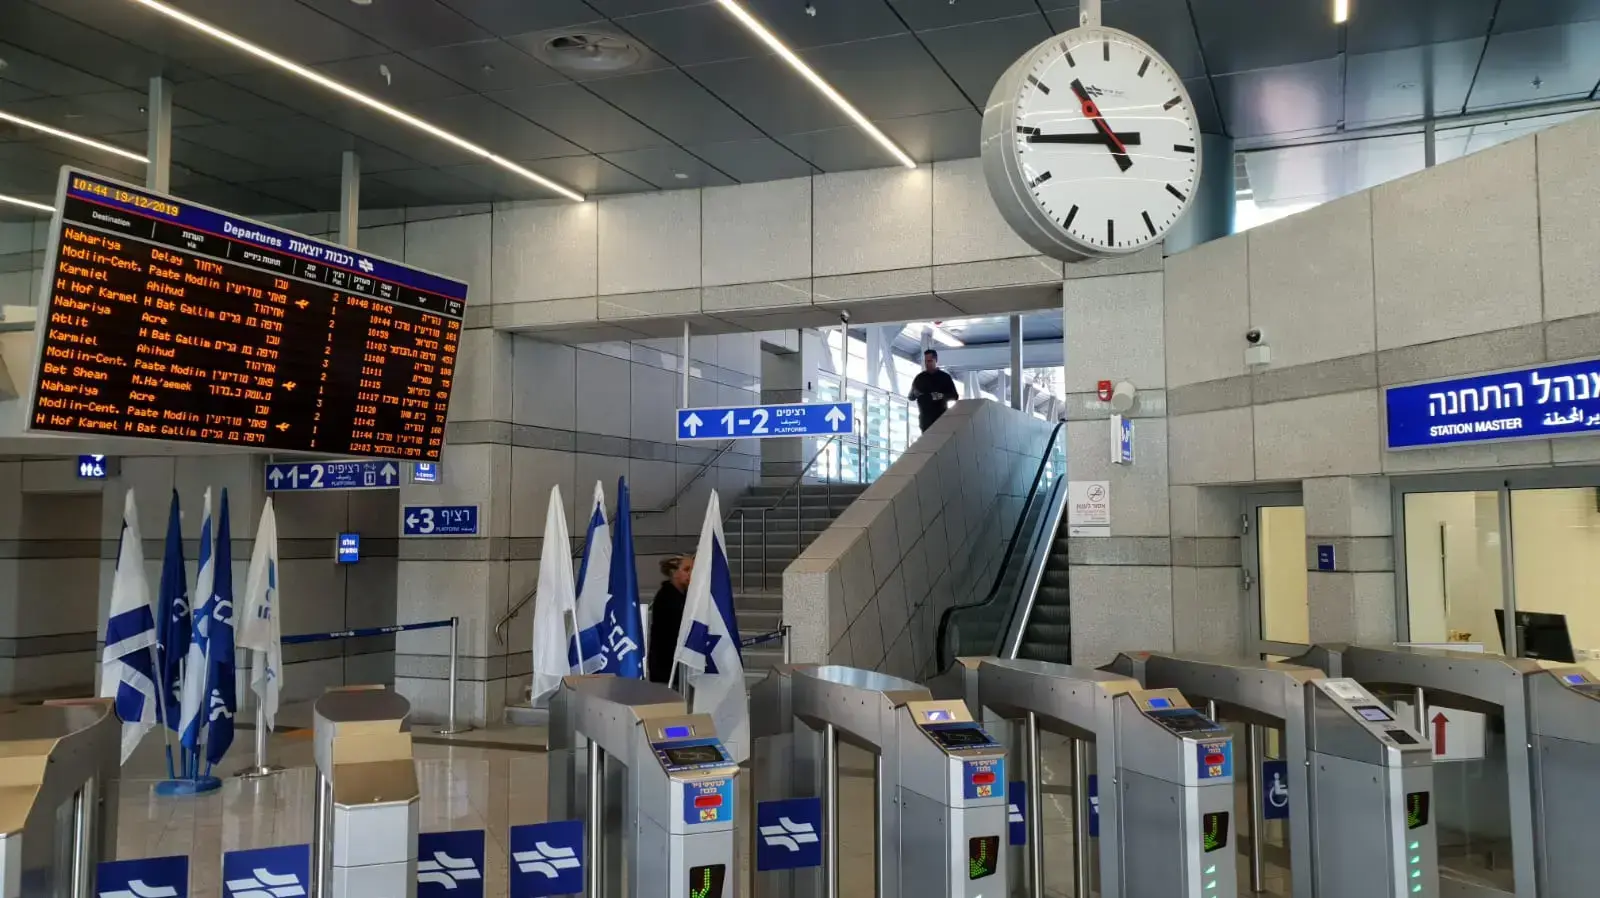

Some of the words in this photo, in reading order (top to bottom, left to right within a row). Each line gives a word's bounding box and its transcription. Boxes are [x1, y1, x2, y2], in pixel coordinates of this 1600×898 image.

[73, 178, 108, 197] 10:44
[115, 190, 178, 216] 19/12/2019
[92, 211, 131, 226] Destination
[64, 228, 120, 250] Nahariya
[223, 221, 282, 247] Departures
[288, 239, 323, 257] יוצאות
[62, 244, 141, 272] Modiin-Cent.
[151, 248, 182, 266] Delay
[324, 249, 354, 267] רכבות
[59, 261, 107, 281] Karmiel
[194, 259, 222, 274] איחור
[148, 264, 180, 280] Paate
[185, 273, 220, 289] Modiin
[56, 278, 64, 288] H
[71, 281, 92, 294] Hof
[98, 286, 137, 304] Karmel
[146, 281, 184, 297] Ahihud
[54, 295, 110, 315] Nahariya
[333, 293, 339, 302] 2
[144, 296, 151, 306] H
[156, 298, 175, 311] Bat
[180, 303, 215, 318] Gallim
[331, 306, 336, 315] 1
[372, 302, 393, 314] 10:43
[51, 312, 87, 327] Atlit
[141, 312, 166, 325] Acre
[328, 319, 335, 329] 2
[370, 315, 391, 327] 10:44
[49, 329, 97, 346] Karmiel
[139, 327, 146, 337] H
[151, 329, 170, 341] Bat
[175, 334, 211, 348] Gallim
[327, 333, 332, 341] 1
[368, 328, 389, 339] 10:59
[136, 343, 174, 358] Ahihud
[324, 346, 331, 355] 2
[366, 340, 387, 352] 11:03
[46, 346, 126, 366] Modiin-Cent.
[322, 359, 329, 368] 3
[44, 362, 65, 375] Bet
[73, 366, 107, 380] Shean
[134, 358, 165, 372] Paate
[170, 364, 206, 377] Modiin
[361, 366, 382, 377] 11:11
[320, 372, 327, 381] 2
[360, 379, 381, 389] 11:15
[41, 379, 97, 396] Nahariya
[319, 386, 323, 394] 1
[129, 390, 154, 402] Acre
[316, 399, 323, 408] 3
[358, 391, 379, 401] 11:17
[1428, 382, 1524, 417] התחנה
[38, 396, 119, 414] Modiin-Cent.
[776, 408, 806, 417] רציפים
[127, 405, 158, 418] Paate
[163, 409, 199, 421] Modiin
[314, 412, 320, 421] 2
[436, 414, 444, 423] 72
[1542, 406, 1584, 426] المحطة
[36, 413, 43, 423] H
[50, 414, 72, 425] Hof
[78, 417, 118, 430] Karmel
[353, 417, 375, 427] 11:43
[720, 408, 769, 434] 1-2
[1429, 422, 1473, 437] STATION
[1474, 417, 1523, 433] MASTER
[124, 422, 131, 430] H
[137, 422, 156, 433] Bat
[161, 425, 197, 436] Gallim
[313, 425, 317, 434] 1
[351, 430, 373, 439] 11:44
[310, 439, 315, 447] 1
[286, 463, 324, 488] 1-2
[328, 463, 360, 474] רציפים
[419, 508, 435, 533] 3
[441, 509, 470, 525] רציף
